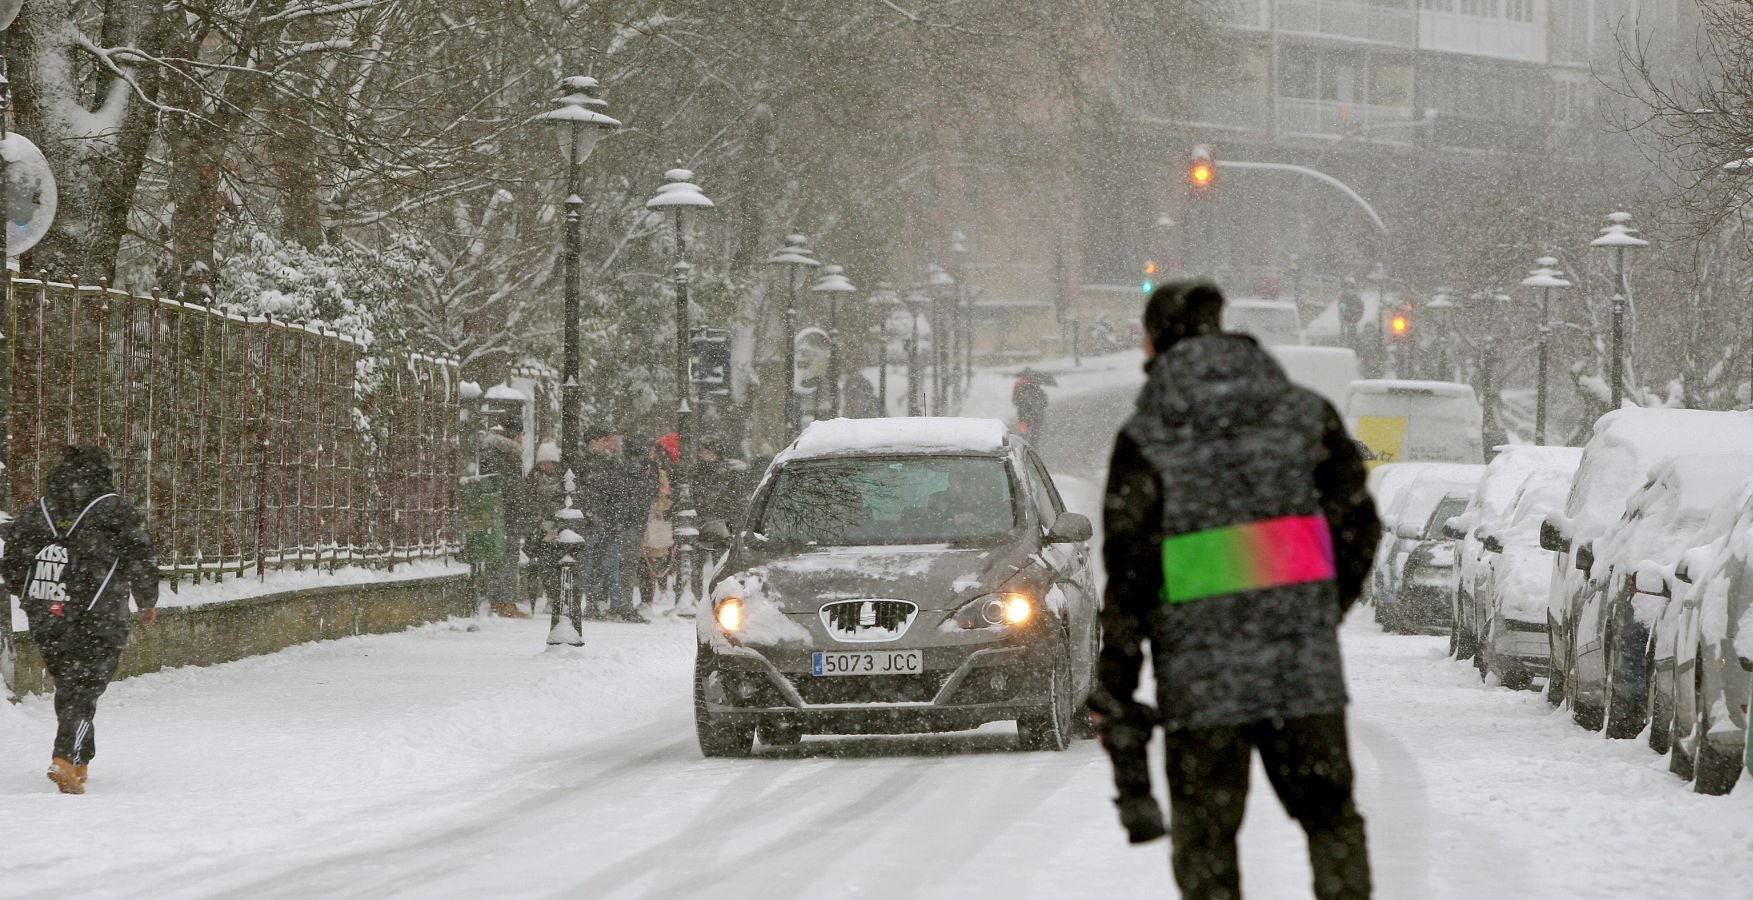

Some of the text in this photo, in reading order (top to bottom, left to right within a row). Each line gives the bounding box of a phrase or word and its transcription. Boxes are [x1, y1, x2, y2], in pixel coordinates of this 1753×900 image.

[34, 561, 65, 581] MY
[29, 579, 71, 601] AIRS.
[825, 654, 874, 672] 5073
[882, 653, 917, 671] JCC
